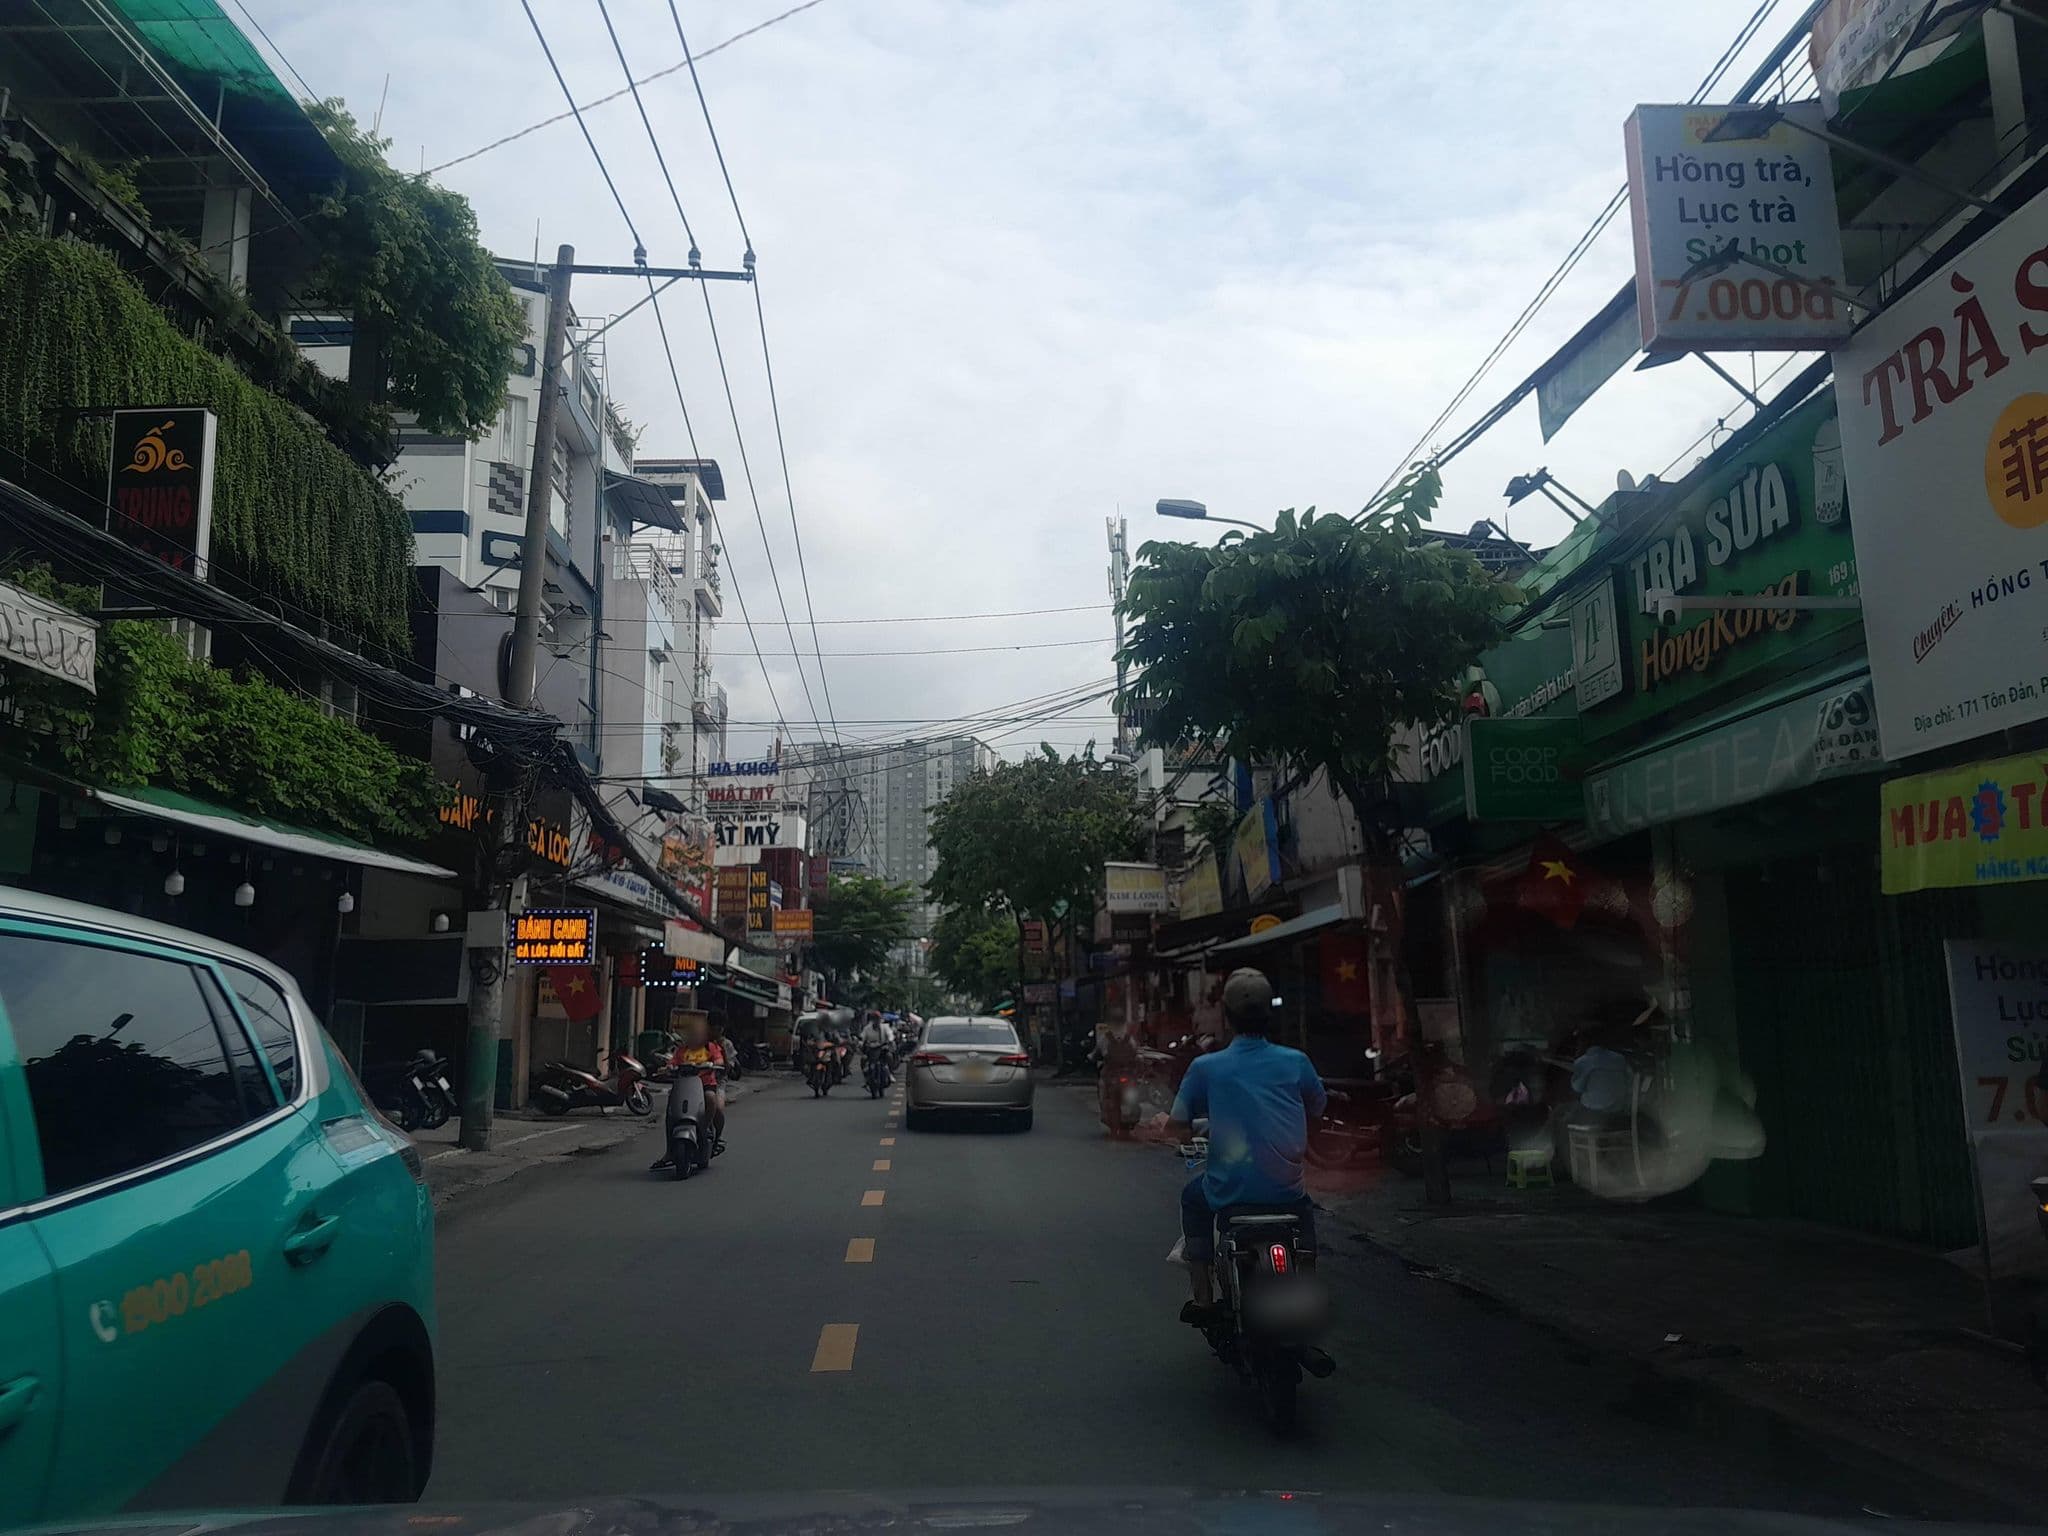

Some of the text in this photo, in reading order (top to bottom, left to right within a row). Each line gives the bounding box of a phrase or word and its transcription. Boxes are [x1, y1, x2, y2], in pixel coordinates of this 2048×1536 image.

[1655, 152, 1811, 188] Hồng trà,
[1678, 195, 1796, 229] Lục trà
[1660, 276, 1836, 321] 7.000đ
[1862, 270, 2010, 447] TRÀ
[115, 485, 194, 529] TRUNG
[1828, 560, 1848, 587] 169
[1913, 600, 1963, 661] Chuyên:
[1971, 568, 2031, 609] HỒNG
[1817, 691, 1870, 734] 169
[1914, 715, 1932, 733] Địa
[1958, 699, 1979, 719] 171
[1982, 692, 2007, 711] Tôn
[735, 762, 779, 776] KHOA
[1489, 765, 1559, 784] FOOD
[1622, 715, 1798, 826] LEETEA
[744, 822, 781, 845] MỸ
[1889, 795, 1967, 849] MUA
[1978, 790, 2000, 837] 3
[517, 914, 587, 940] BÁNH CANH
[515, 942, 530, 958] CÁ
[530, 942, 549, 958] LÓC
[119, 1271, 190, 1335] 1900
